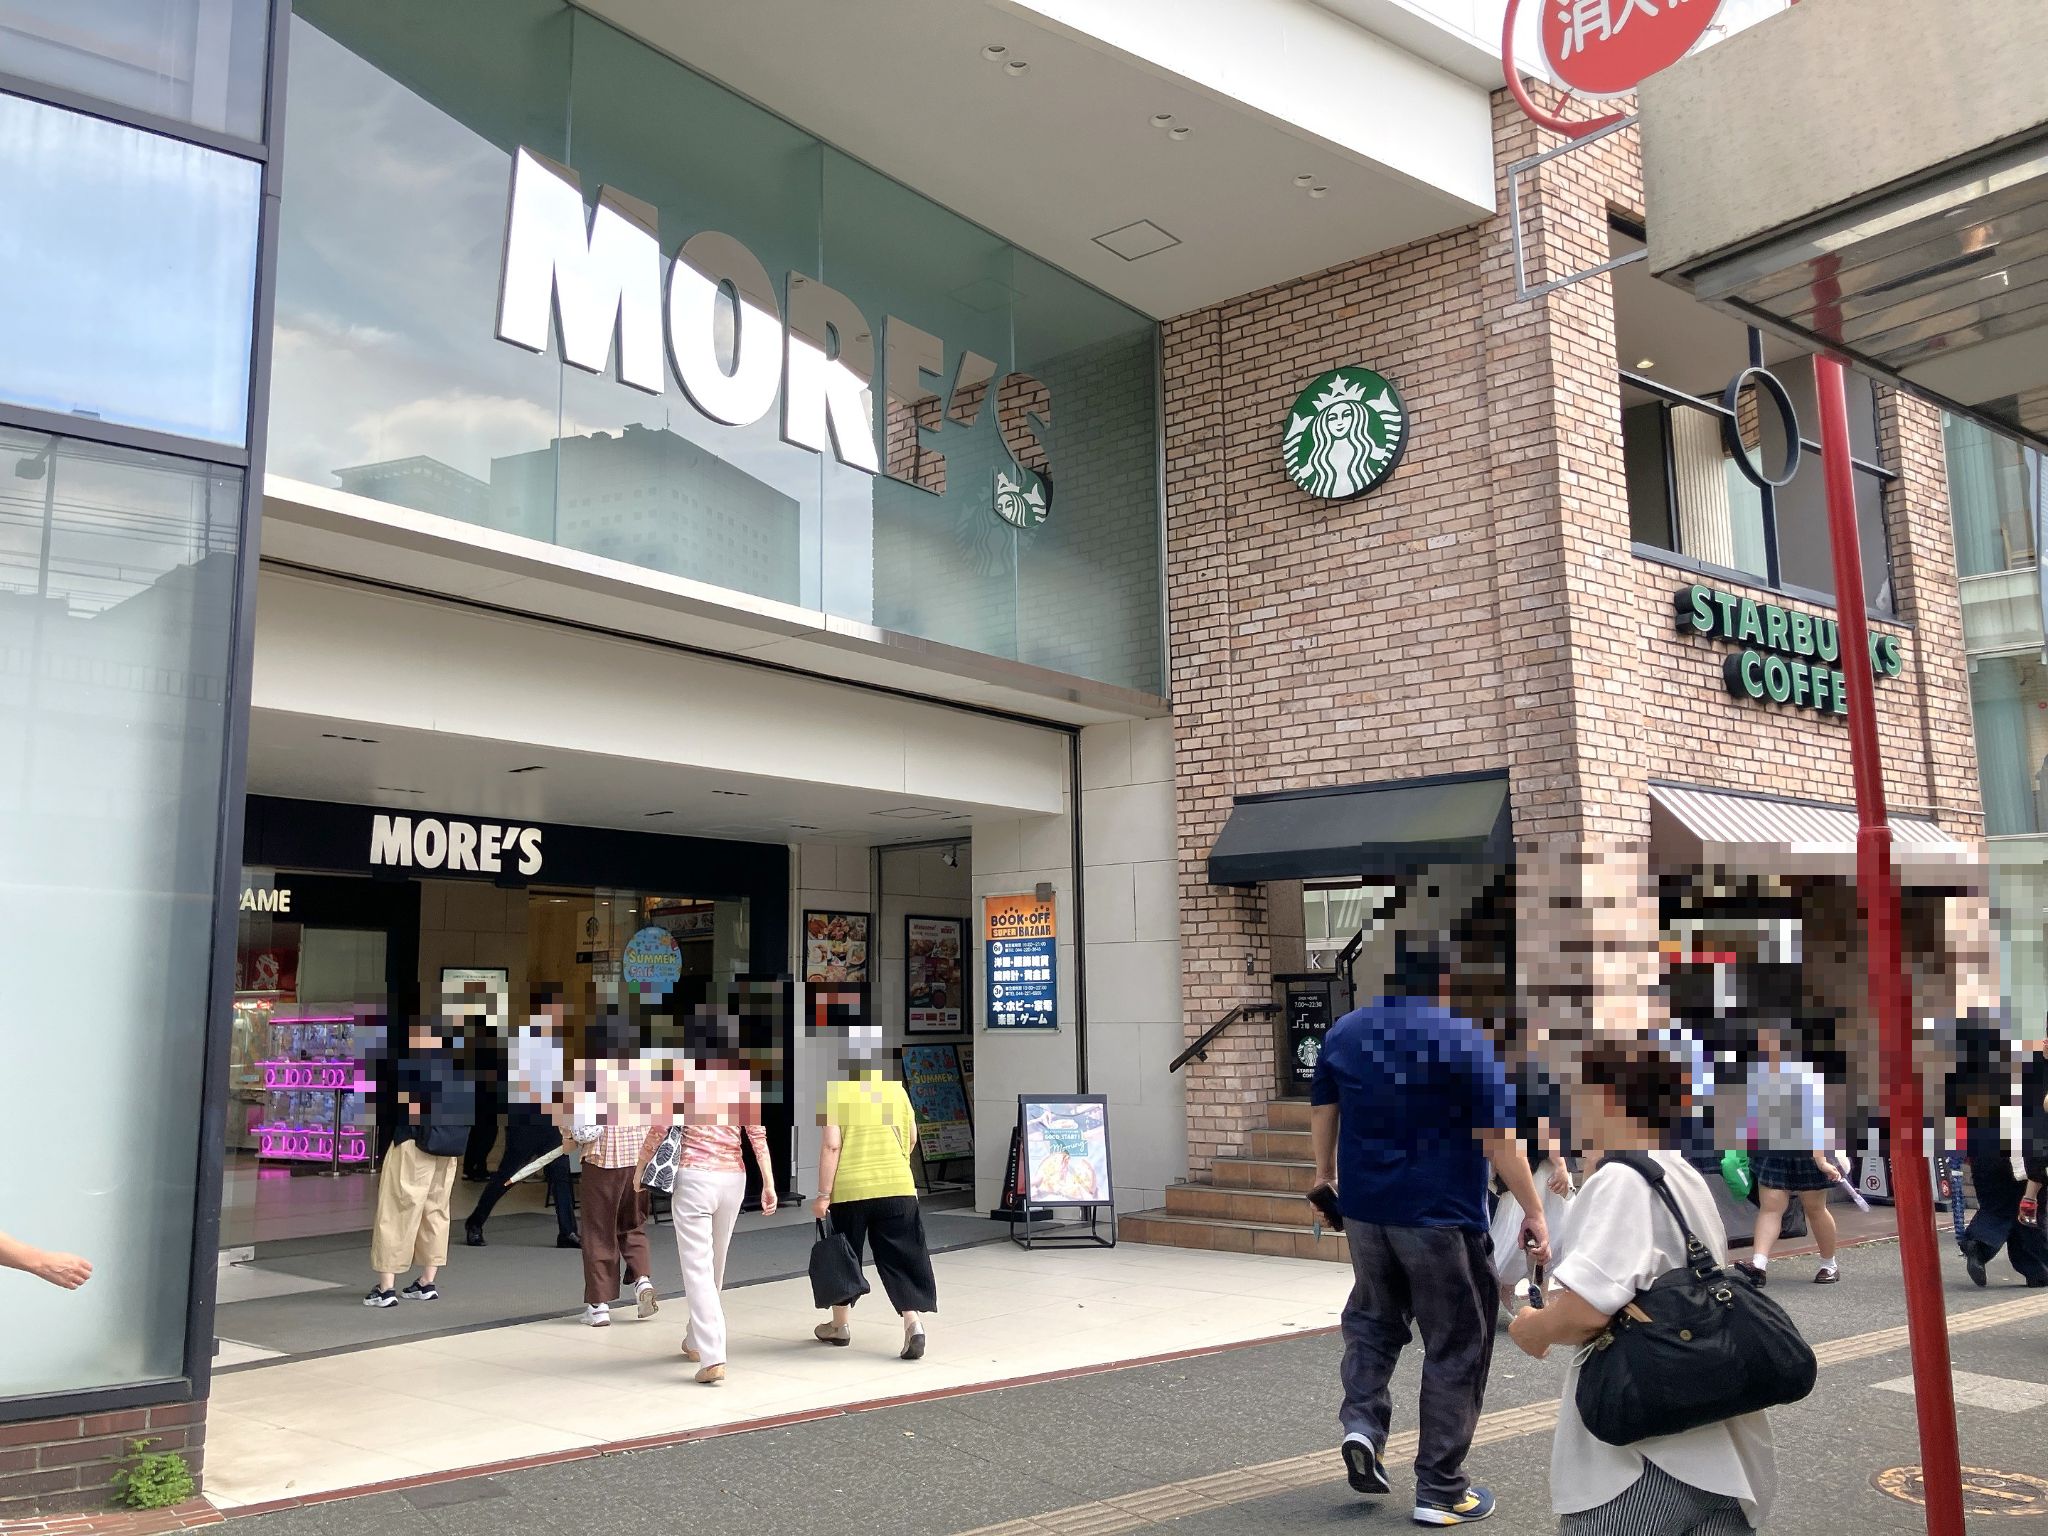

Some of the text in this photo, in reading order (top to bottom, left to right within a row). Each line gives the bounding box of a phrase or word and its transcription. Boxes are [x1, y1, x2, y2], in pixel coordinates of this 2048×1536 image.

[1690, 584, 1902, 678] STARBUKS
[1740, 650, 1850, 715] COFFE
[370, 814, 543, 876] MORE'S
[239, 888, 291, 912] AME
[993, 925, 1051, 937] SUPER BAZAAR
[629, 952, 676, 964] SUMMER
[914, 1073, 954, 1084] SUMMER
